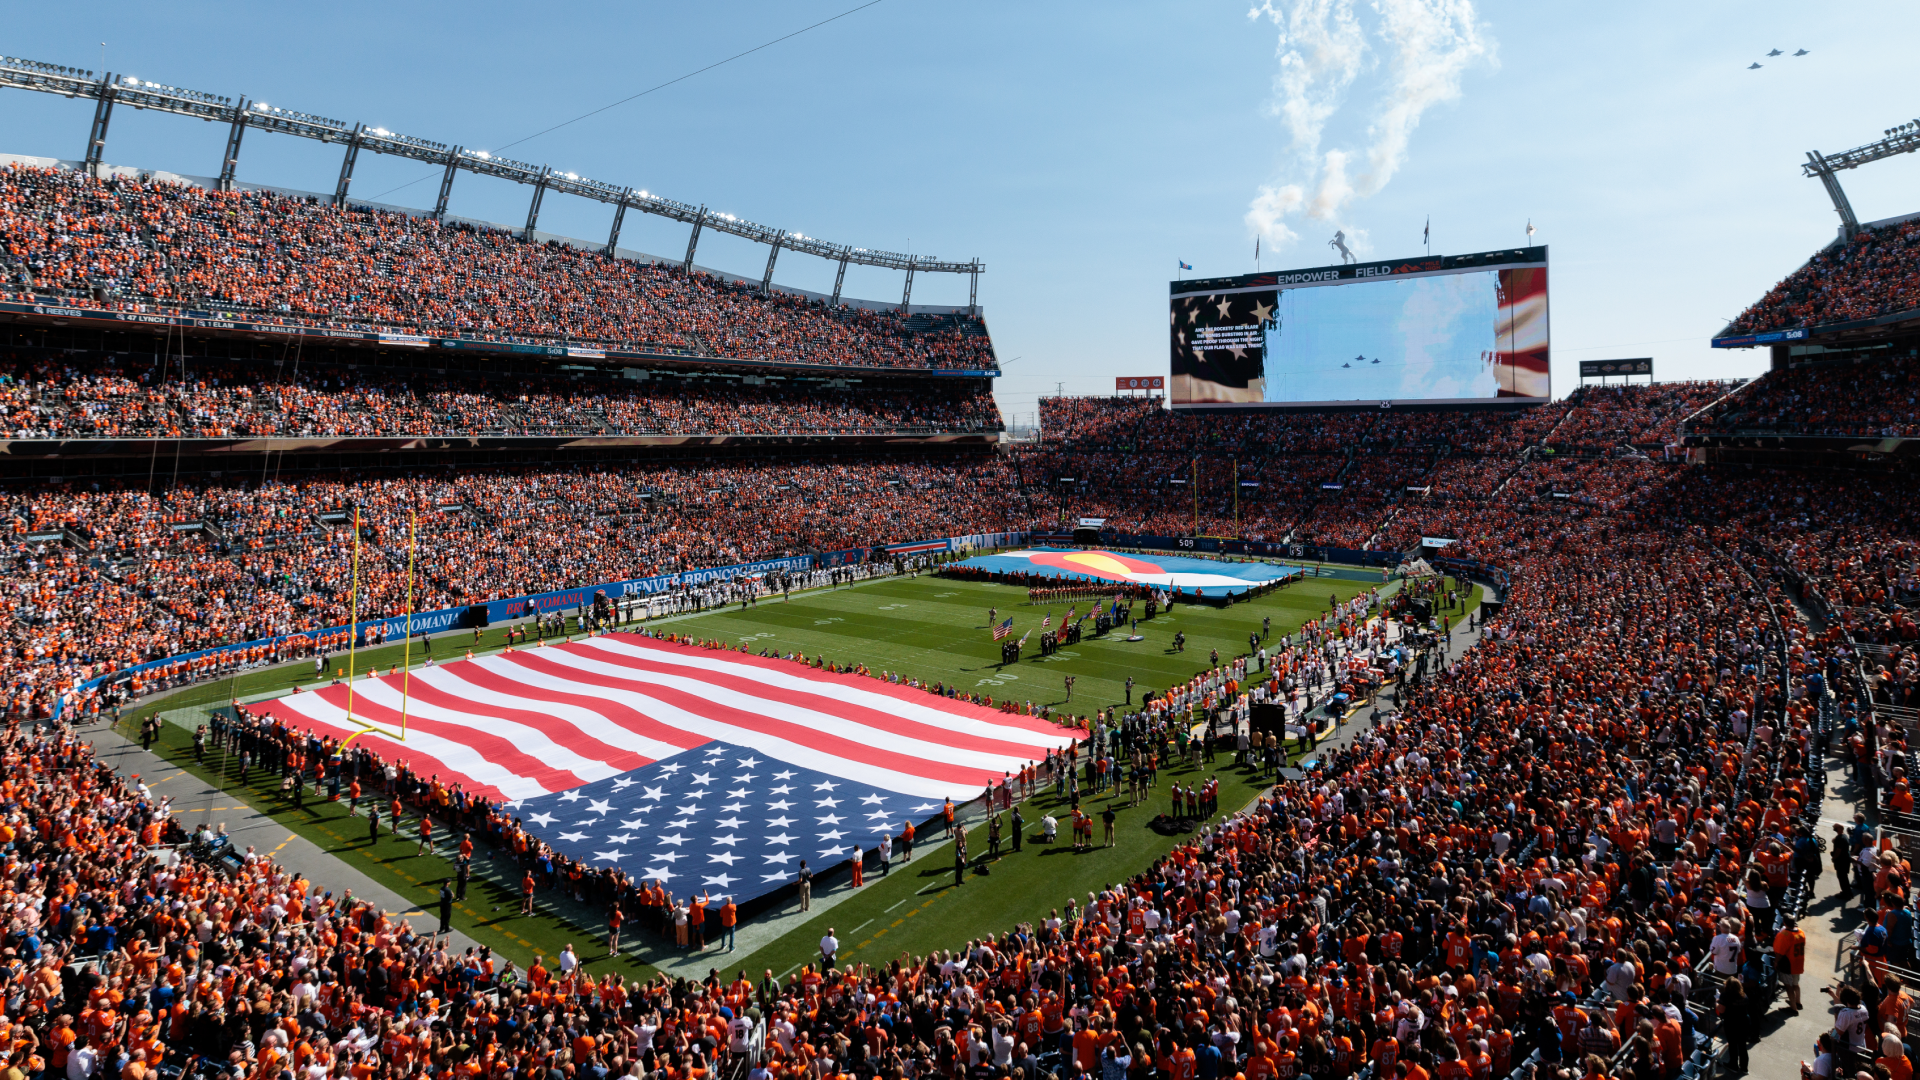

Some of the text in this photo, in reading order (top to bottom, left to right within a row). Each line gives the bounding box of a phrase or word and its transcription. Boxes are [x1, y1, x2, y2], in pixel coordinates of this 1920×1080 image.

[1278, 266, 1391, 285] EMPOWER FIELD
[46, 308, 82, 317] REEVES
[1786, 330, 1802, 339] 5:08
[622, 576, 681, 595] DENVER
[1568, 835, 1578, 844] 18
[1132, 916, 1141, 925] 18
[1454, 946, 1464, 957] 10
[1729, 947, 1738, 962] 7
[1028, 1022, 1038, 1033] 88
[1568, 1021, 1577, 1036] 7
[735, 1030, 744, 1038] 18
[1382, 1052, 1395, 1065] 87
[1183, 1062, 1190, 1078] 2
[1280, 1065, 1293, 1076] 30
